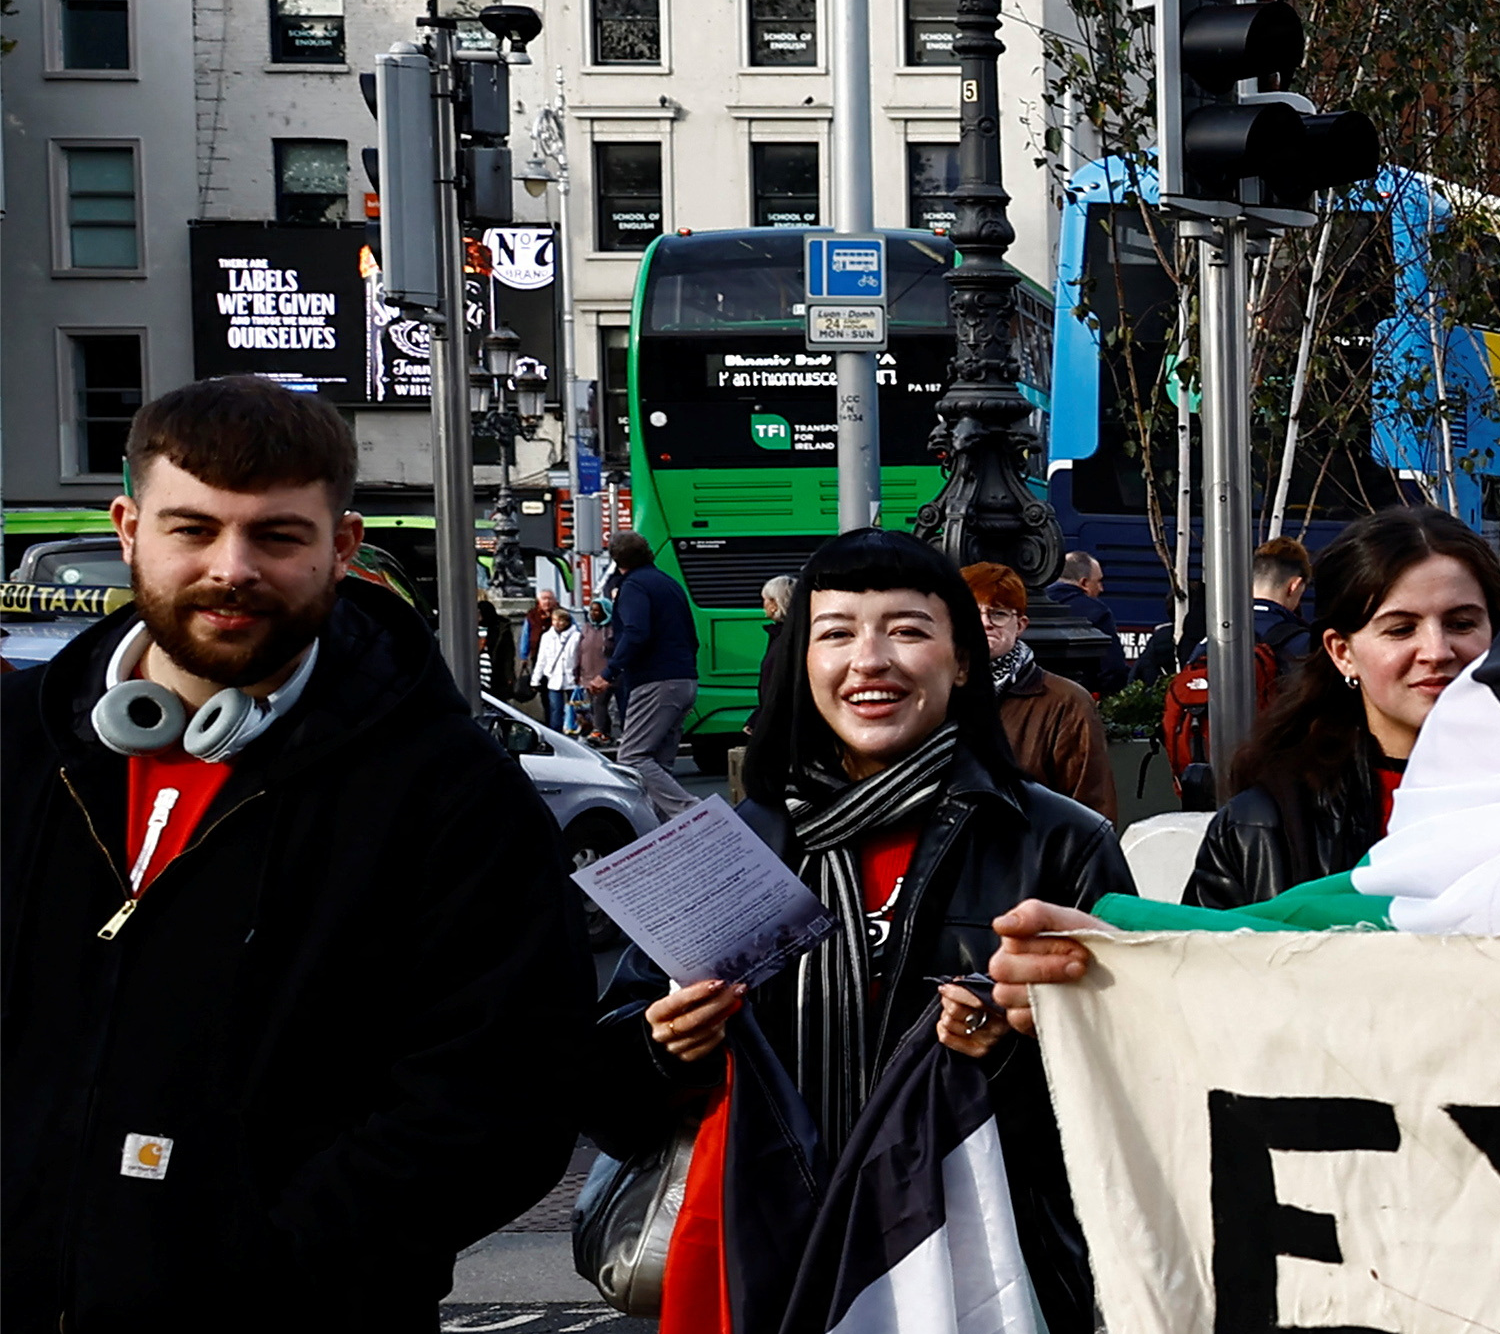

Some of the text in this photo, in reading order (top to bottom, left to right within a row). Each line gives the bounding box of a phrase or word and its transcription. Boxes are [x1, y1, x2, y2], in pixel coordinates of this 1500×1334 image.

[763, 32, 812, 41] SCHOOL OF
[920, 32, 954, 41] SCHOOL
[770, 42, 806, 50] ENGLISH
[965, 83, 975, 100] 5
[612, 212, 660, 221] SCHOOL OF
[767, 212, 815, 221] SCHOOL OF
[923, 212, 956, 221] SCHOOL
[618, 222, 654, 230] ENGLISH
[229, 269, 298, 292] LABELS
[217, 293, 335, 315] WE'RE GIVEN
[825, 318, 840, 330] 24
[227, 326, 336, 349] OURSELVES
[819, 330, 844, 338] MON
[852, 330, 874, 338] SUN
[908, 384, 941, 392] PA 187
[755, 424, 785, 438] TFI
[794, 424, 838, 432] TRANSPO
[794, 433, 814, 441] FOR
[794, 442, 835, 450] IRELAND
[37, 587, 100, 613] TAXI
